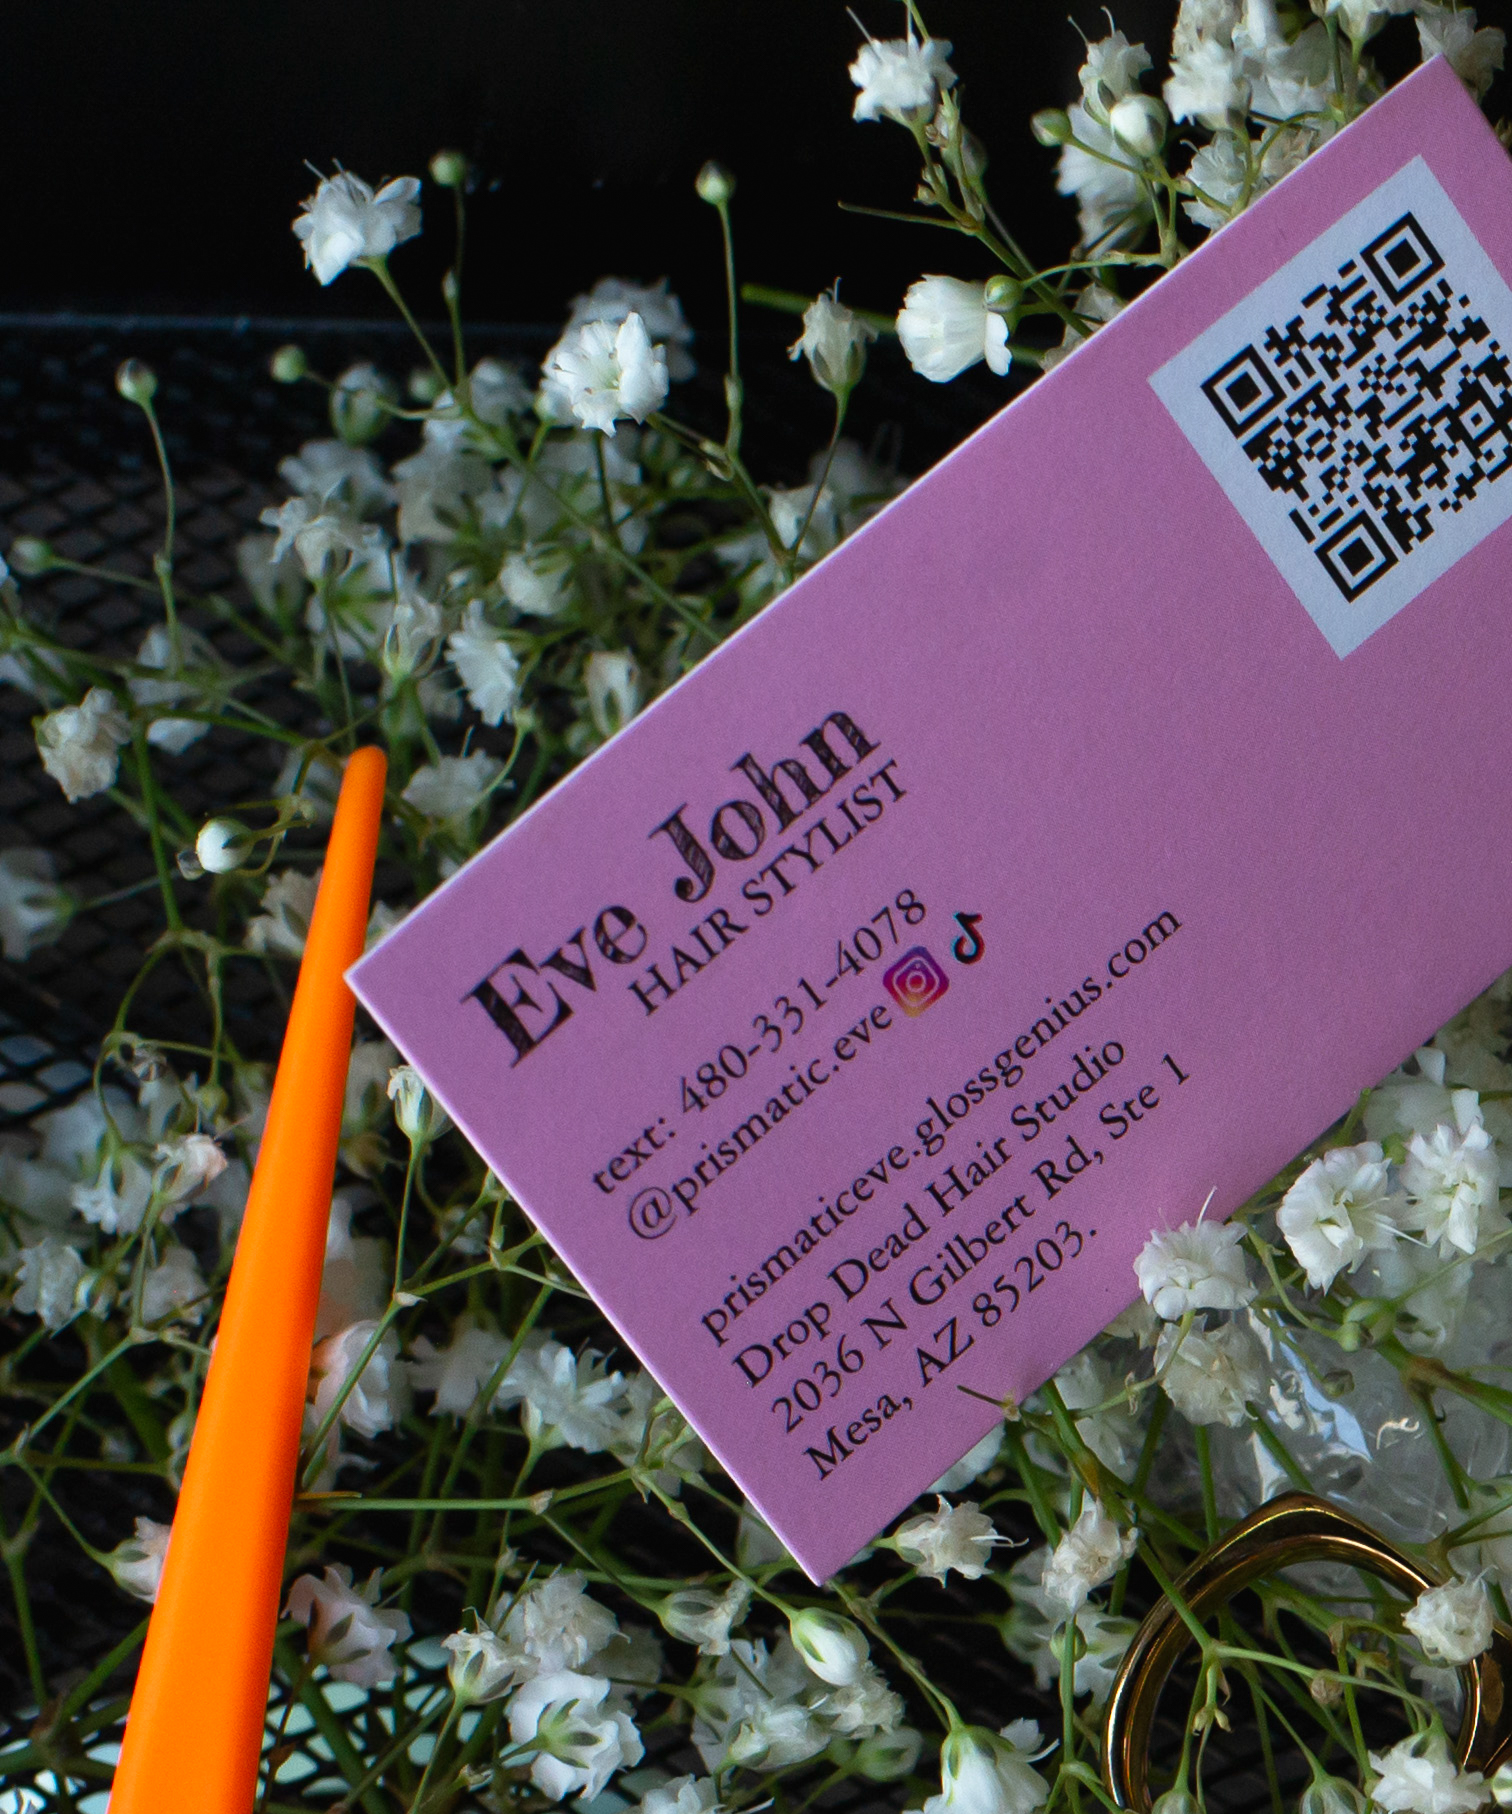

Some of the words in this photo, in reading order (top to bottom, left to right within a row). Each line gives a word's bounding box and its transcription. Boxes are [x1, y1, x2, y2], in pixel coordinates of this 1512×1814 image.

[461, 902, 648, 1068] Eve
[649, 711, 880, 904] John
[592, 1117, 676, 1197] text:
[678, 887, 928, 1118] 480-331-4078
[626, 908, 749, 1017] HAIR
[741, 760, 908, 921] STYLIST
[627, 1001, 893, 1241] @prismatic.eve
[699, 908, 1182, 1347] prismaticeve.glossgenius.com
[731, 1316, 832, 1388] Drop
[828, 1205, 929, 1302] Dead
[923, 1135, 1011, 1232] Hair
[1009, 1035, 1125, 1143] Studio
[769, 1336, 865, 1434] 2036
[861, 1301, 909, 1359] N
[908, 1196, 1036, 1307] Gilbert
[1030, 1135, 1105, 1199] Rd,
[1101, 1085, 1161, 1143] Ste
[1164, 1052, 1190, 1086] 1
[802, 1394, 915, 1481] Mesa,
[910, 1315, 975, 1388] AZ
[971, 1220, 1097, 1327] 85203.
